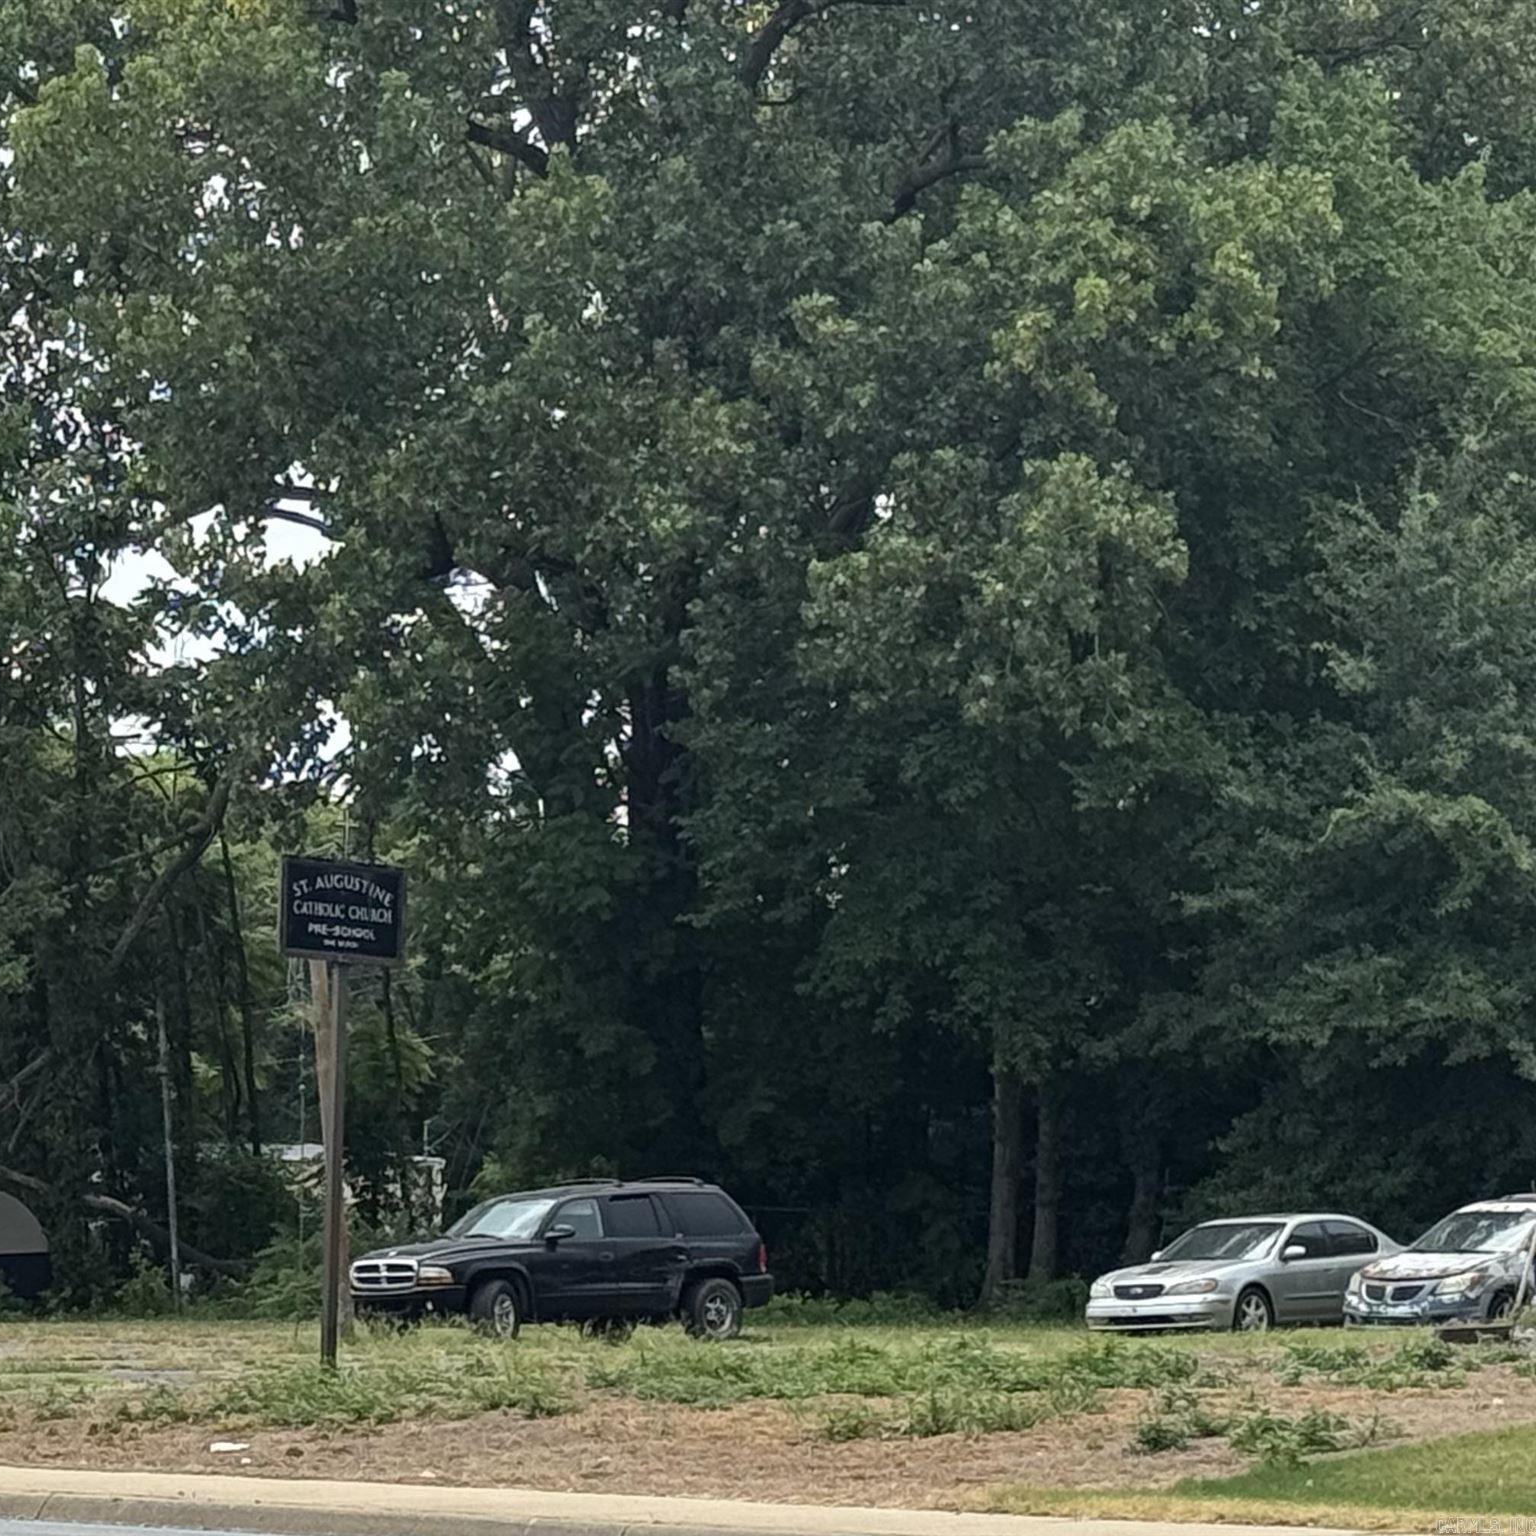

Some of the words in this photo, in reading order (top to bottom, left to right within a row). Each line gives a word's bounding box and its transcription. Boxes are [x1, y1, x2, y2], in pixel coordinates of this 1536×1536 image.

[292, 879, 312, 897] ST.
[315, 874, 394, 907] AUGUSTINE
[292, 899, 345, 919] CATHOLIC
[348, 905, 392, 924] CHURCH
[307, 922, 375, 940] PRE-SCHOOL
